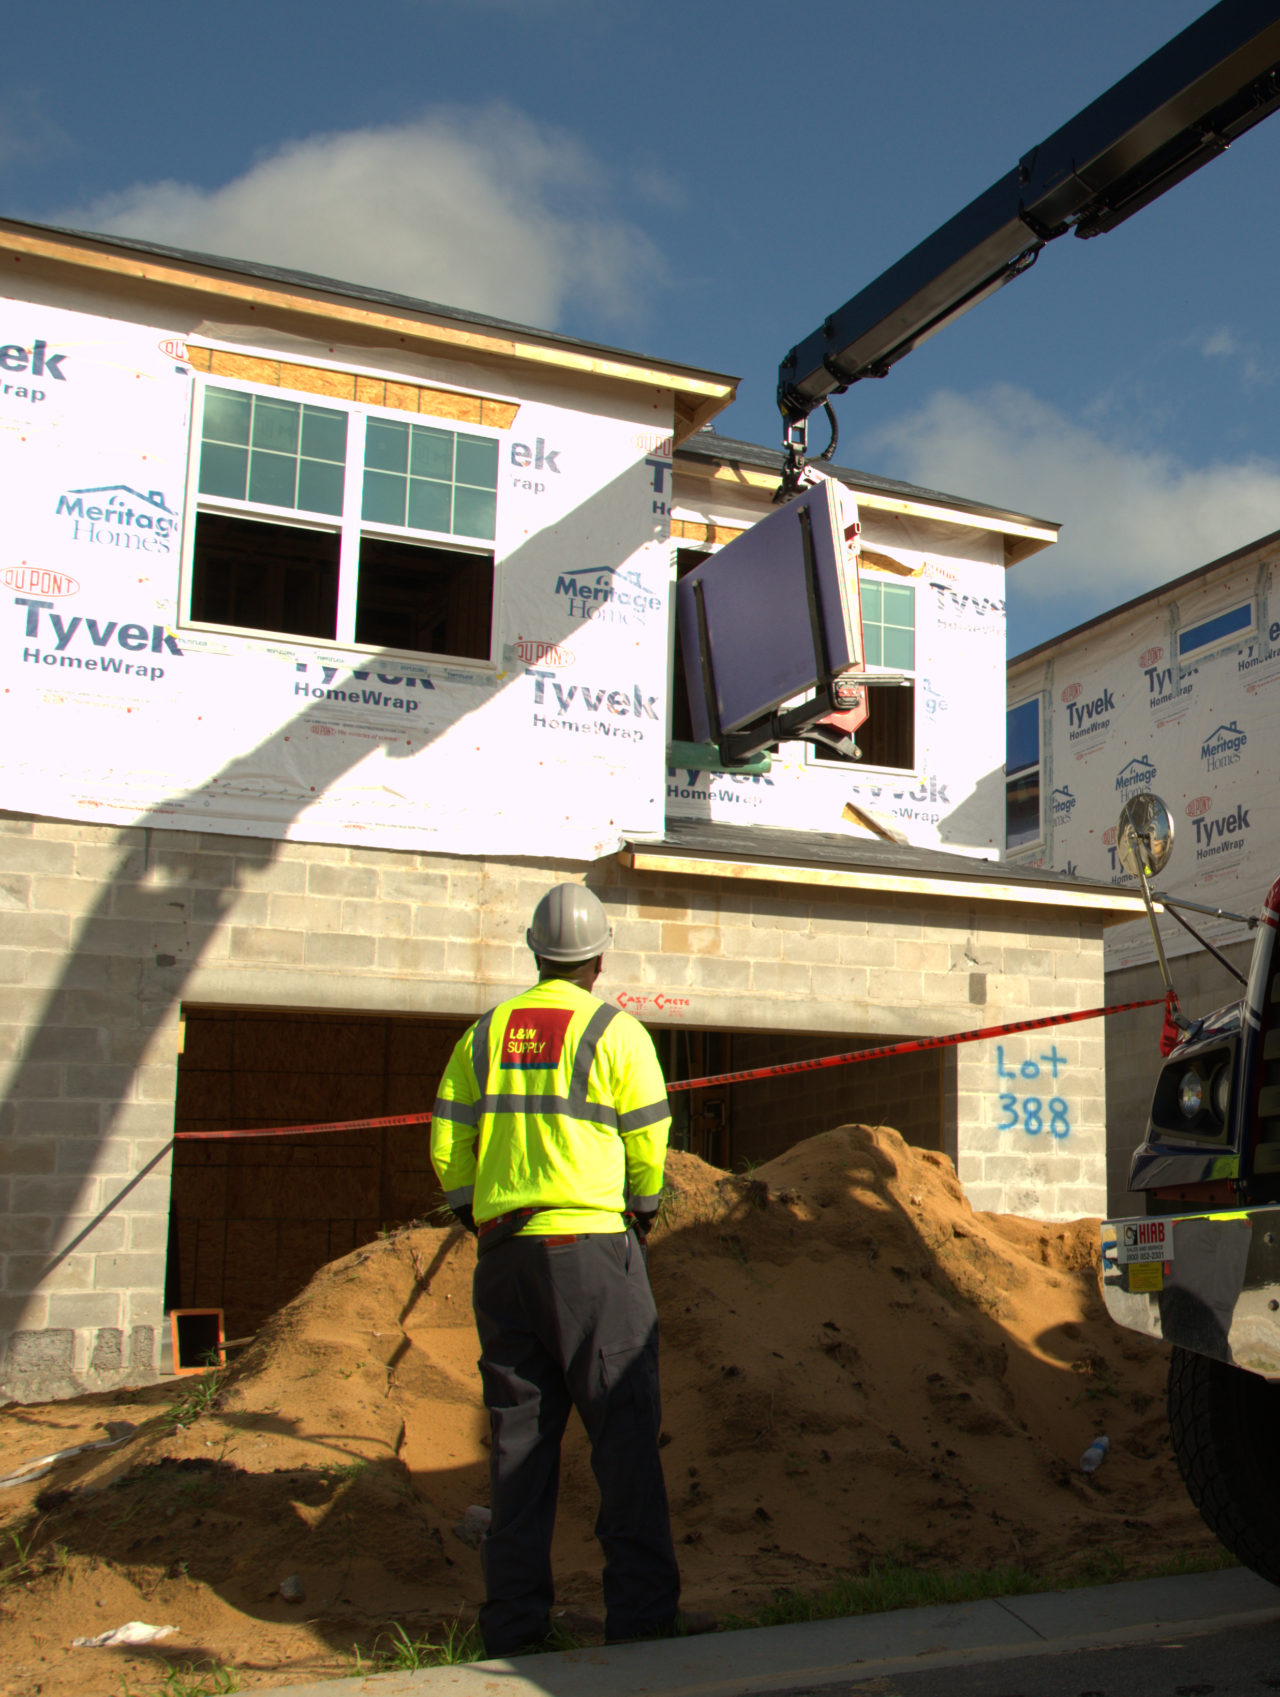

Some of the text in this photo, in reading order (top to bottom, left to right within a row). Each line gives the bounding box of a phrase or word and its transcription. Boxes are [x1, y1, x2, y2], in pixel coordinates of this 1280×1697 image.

[72, 519, 171, 554] Homes
[15, 597, 184, 657] Tyvek
[23, 647, 165, 682] HomeWrap
[293, 681, 419, 713] HomeWrap
[525, 667, 660, 721] Tyvek
[1066, 688, 1116, 729] Tyvek
[1069, 719, 1111, 742] HomeWrap
[1201, 734, 1247, 760] Meritage
[1207, 751, 1241, 772] Homes
[1115, 766, 1158, 791] Meritage
[1192, 804, 1251, 847] Tyvek
[1197, 839, 1244, 861] HomeWrap
[506, 1041, 547, 1055] SUPPLY
[509, 1028, 537, 1040] L&W
[997, 1045, 1068, 1080] Lot
[997, 1092, 1071, 1139] 388
[1139, 1222, 1165, 1244] HIAB
